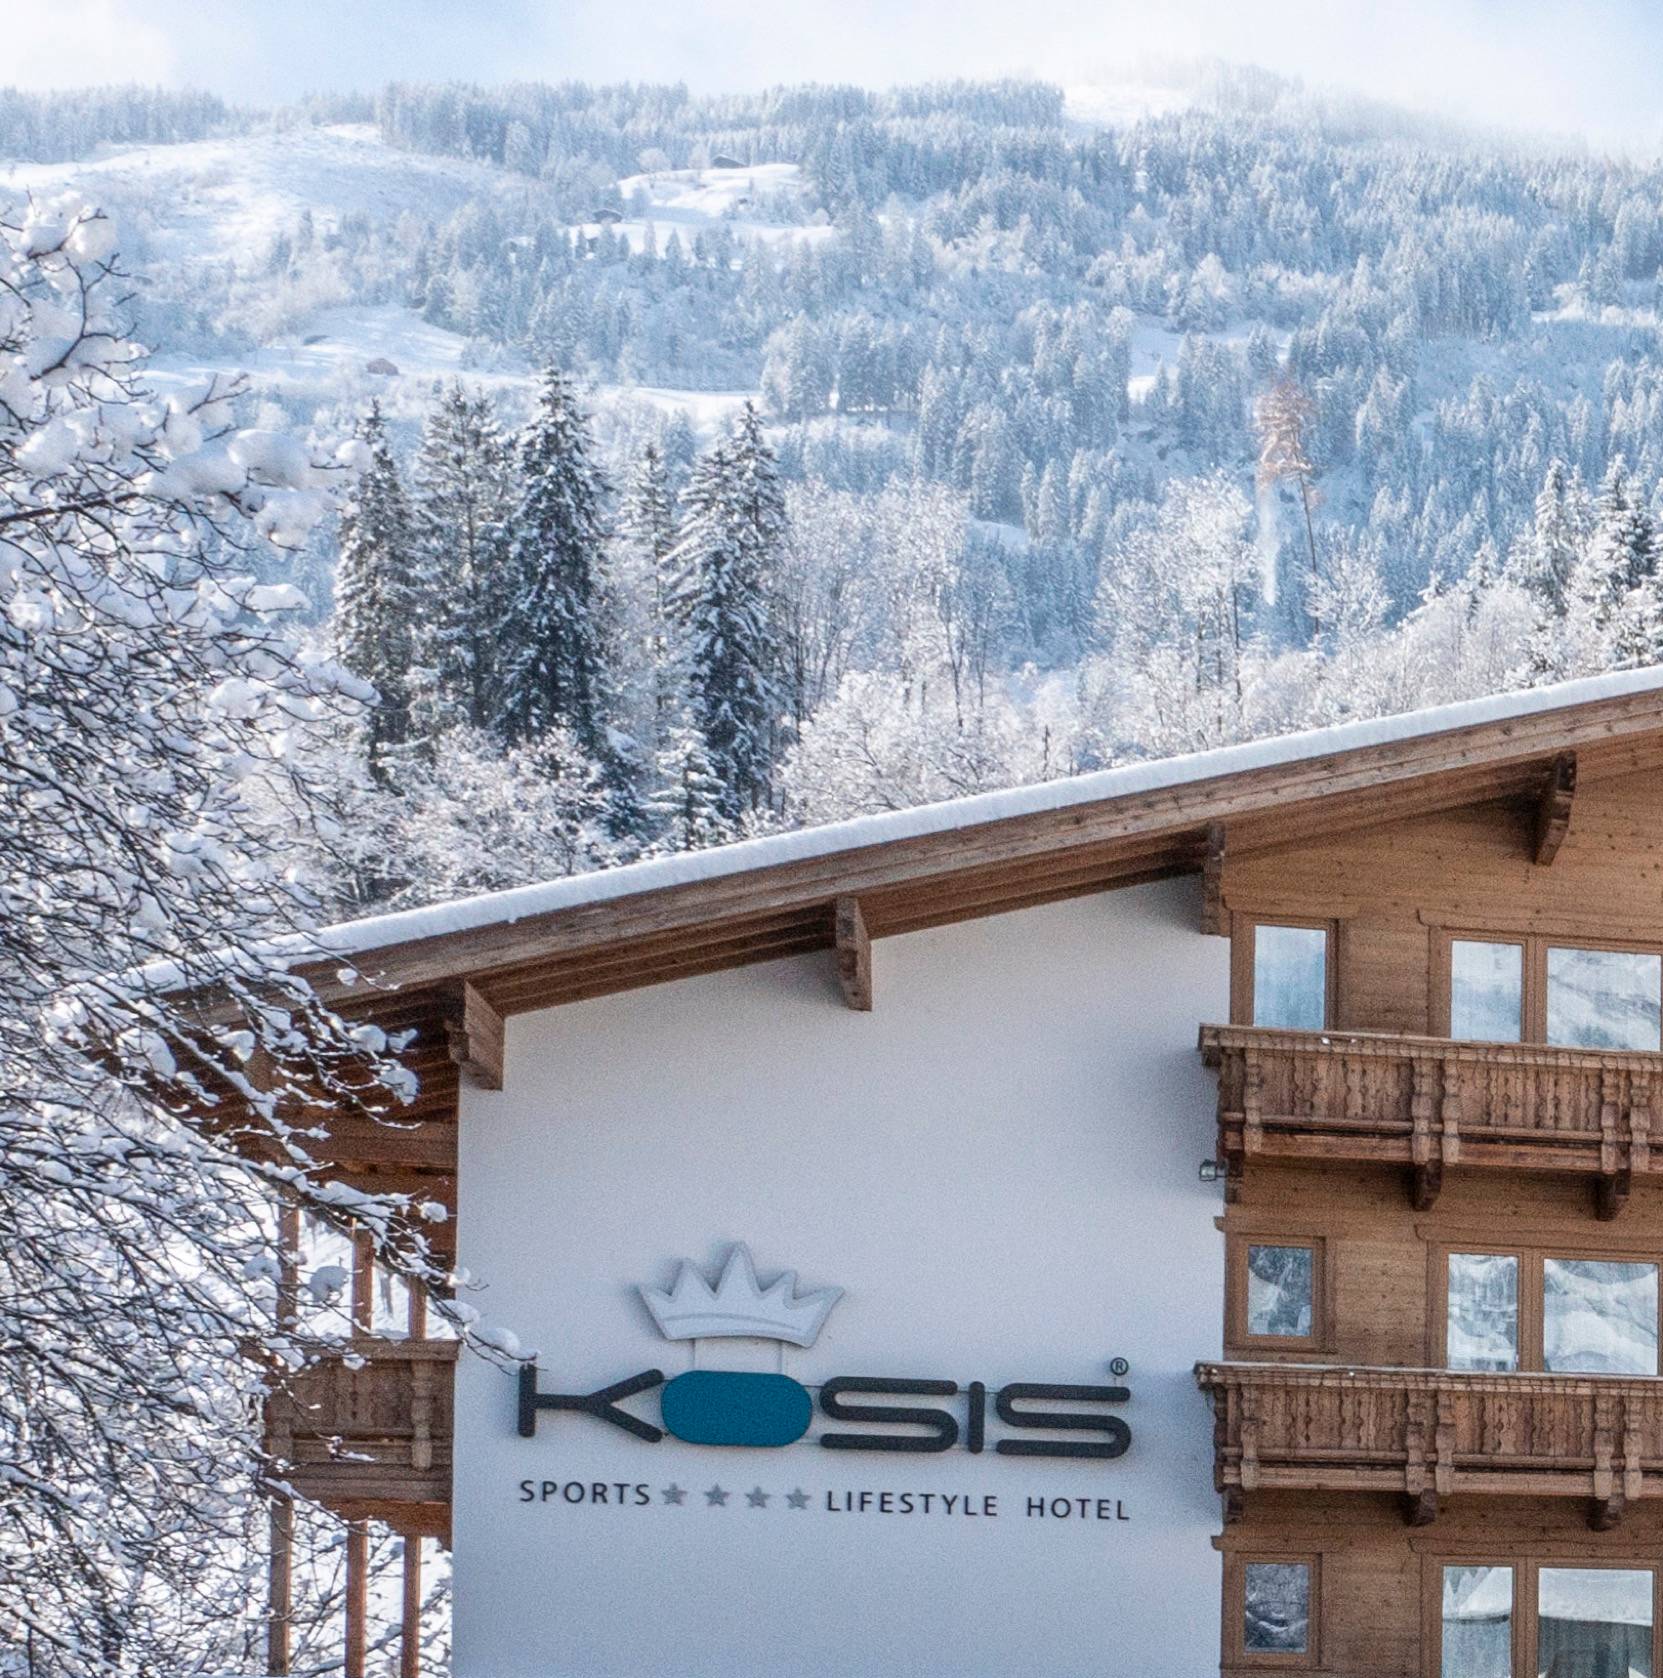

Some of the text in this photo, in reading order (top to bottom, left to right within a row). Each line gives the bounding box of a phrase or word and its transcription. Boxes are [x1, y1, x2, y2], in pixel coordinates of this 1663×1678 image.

[517, 1364, 1131, 1458] KOSIS
[519, 1480, 1130, 1521] SPORTS LIFESTYLE HOTEL
